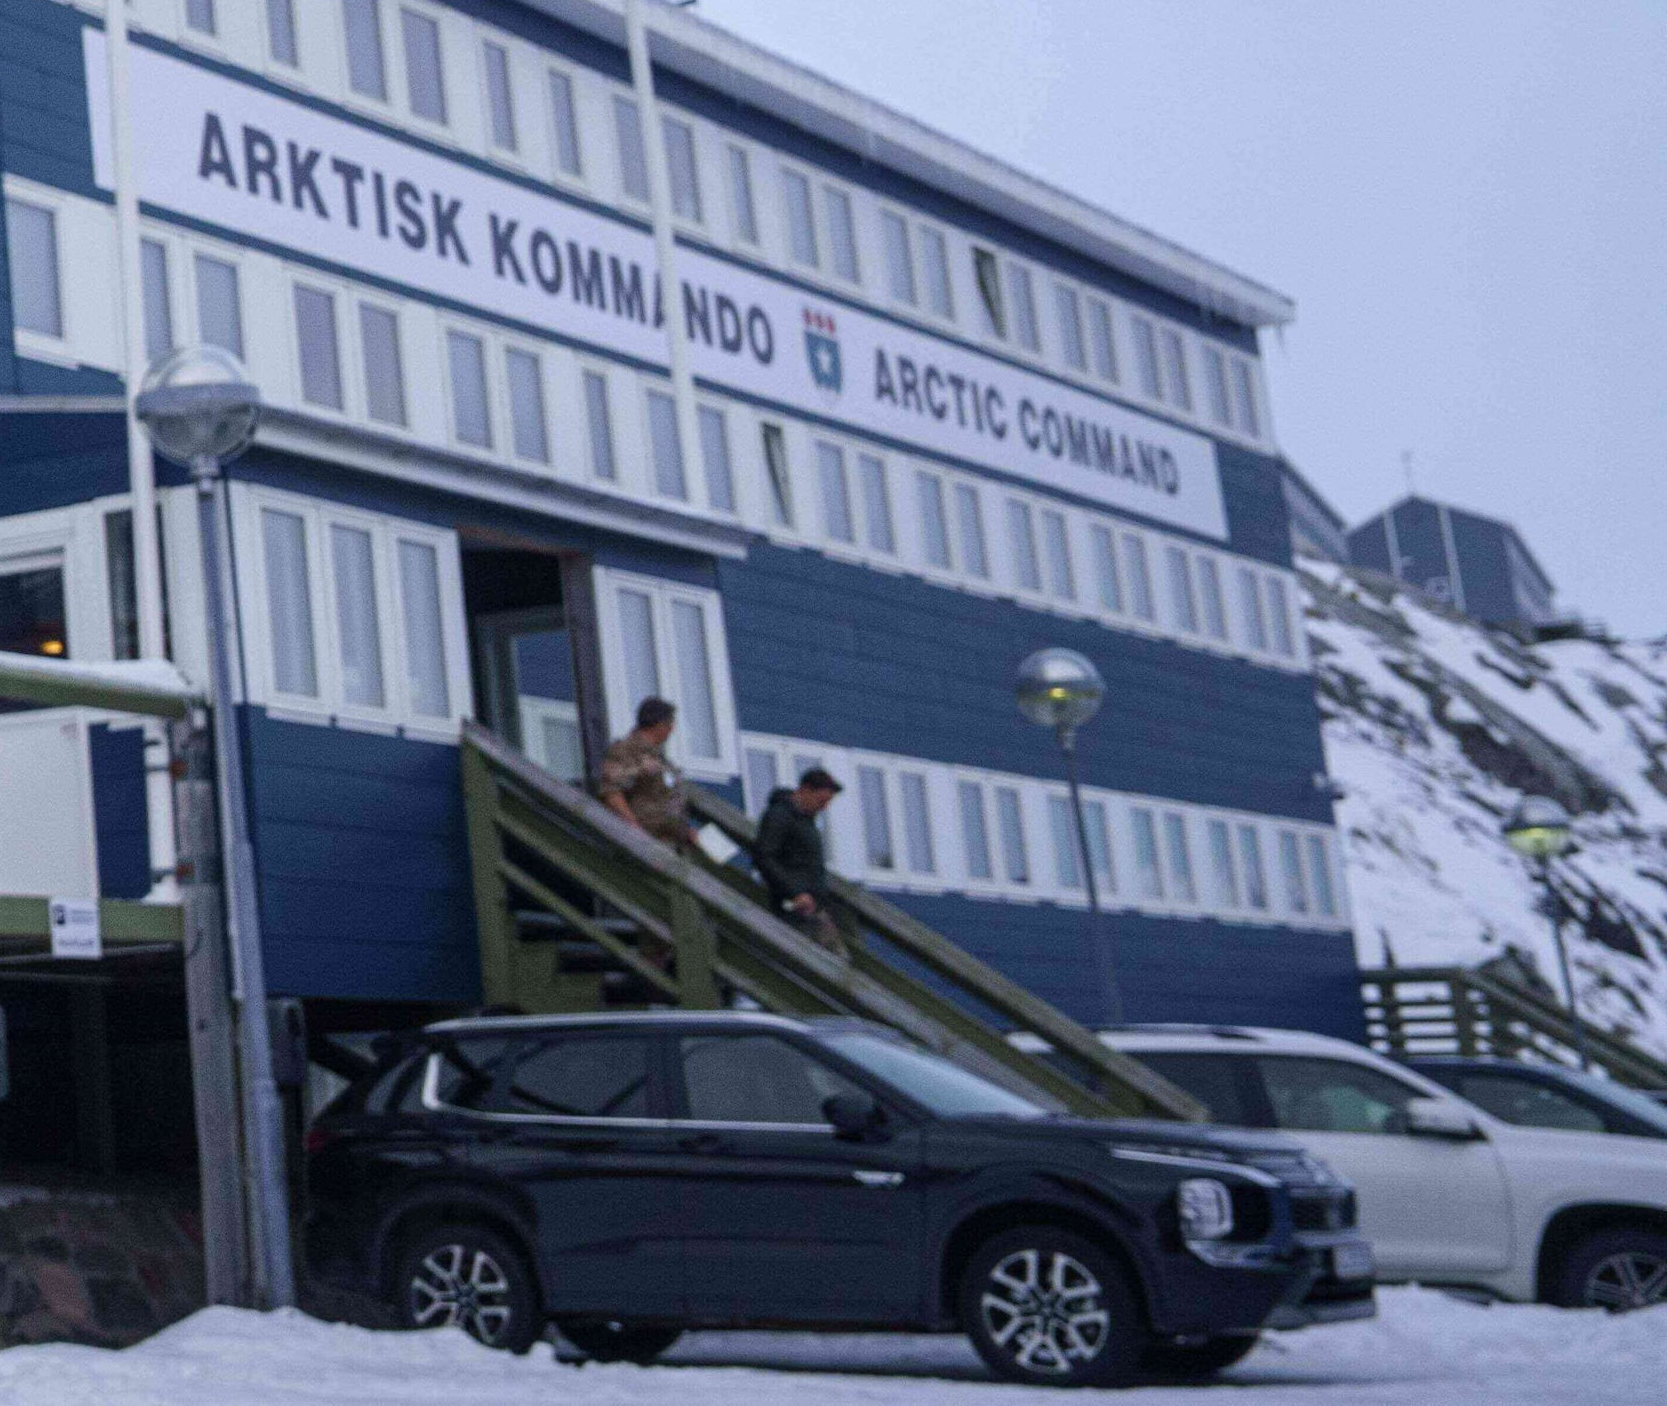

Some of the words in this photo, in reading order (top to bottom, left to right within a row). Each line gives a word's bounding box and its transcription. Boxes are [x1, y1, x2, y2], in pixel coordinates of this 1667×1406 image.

[197, 111, 470, 267] ARKTISK
[874, 347, 1008, 442] ARCTIC
[1019, 396, 1181, 495] COMMAND
